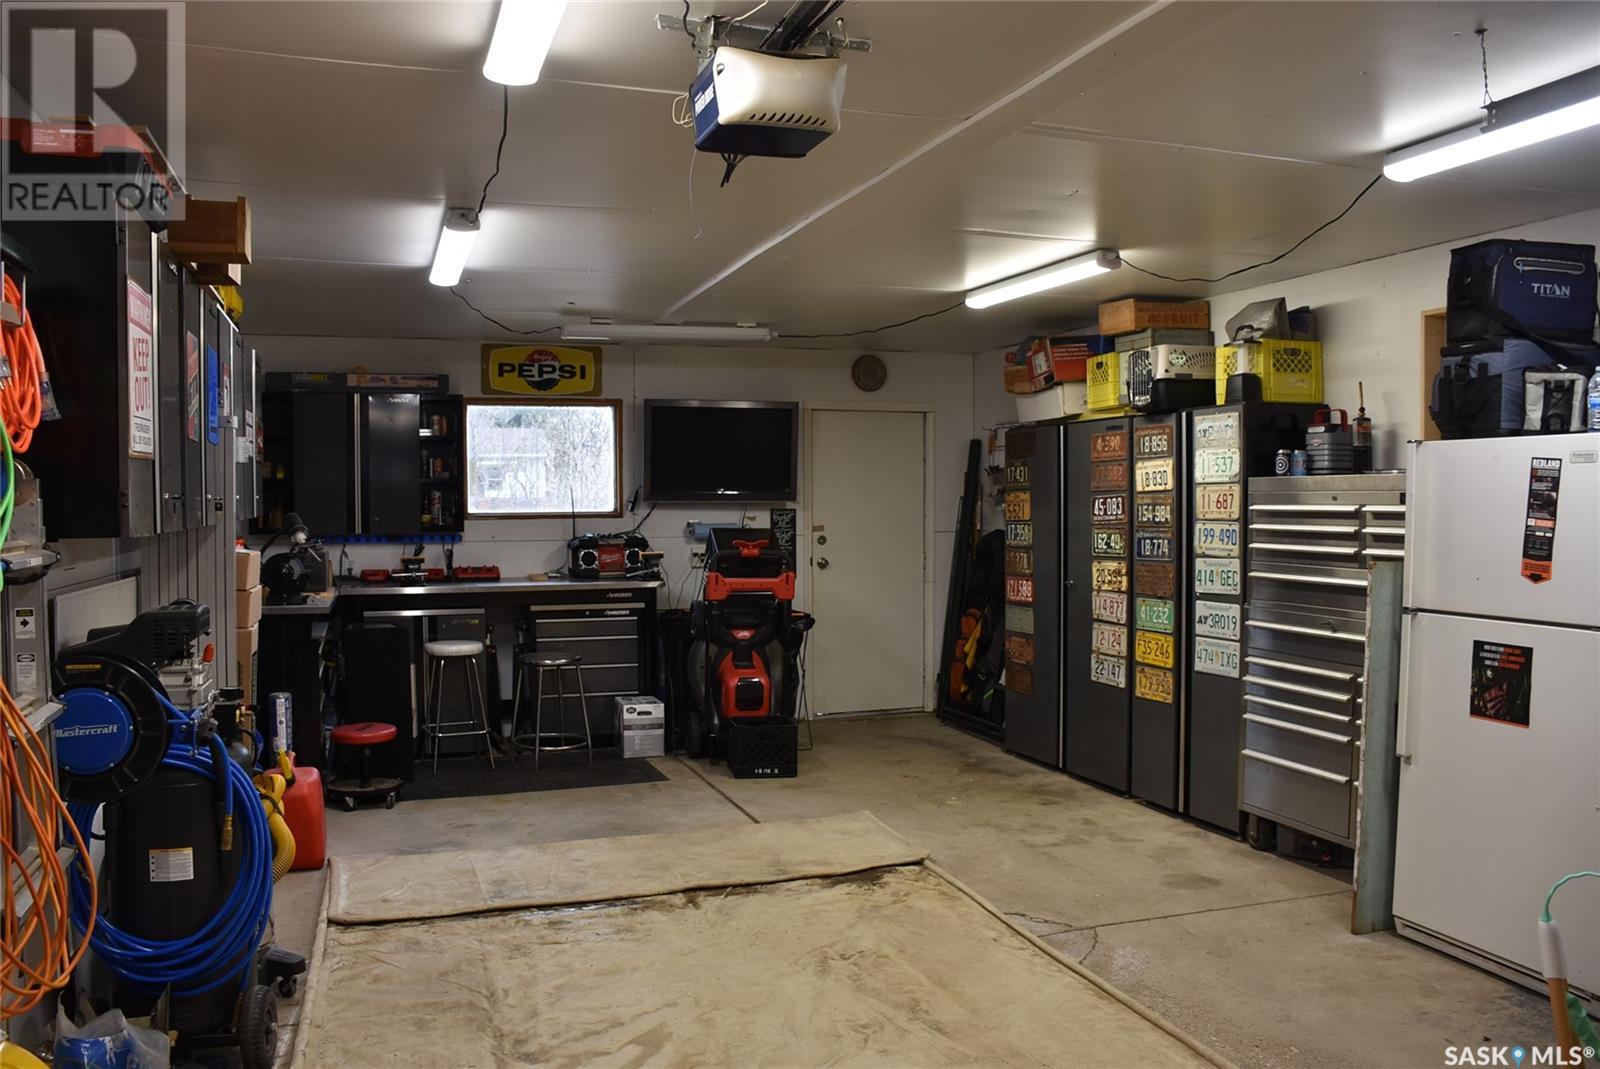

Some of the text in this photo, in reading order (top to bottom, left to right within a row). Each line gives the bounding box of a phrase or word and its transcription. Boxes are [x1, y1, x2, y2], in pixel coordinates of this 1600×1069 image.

[1531, 283, 1570, 297] TITAN
[132, 337, 149, 372] KEEP
[498, 363, 586, 379] PEPSI
[1140, 435, 1168, 453] 18-856
[1202, 456, 1233, 474] 11-537
[1141, 470, 1168, 488] 18-830
[1094, 498, 1122, 516] 45-083
[1202, 493, 1234, 510] 11-687
[1138, 505, 1170, 522] 154-984
[1198, 527, 1237, 546] 199-490
[1141, 539, 1168, 556] 18-774
[1197, 569, 1238, 587] 414 GEC
[1140, 606, 1169, 623] 41-232
[1137, 638, 1170, 659] F35-246
[1197, 648, 1214, 664] 474
[1095, 660, 1121, 679] 22-147
